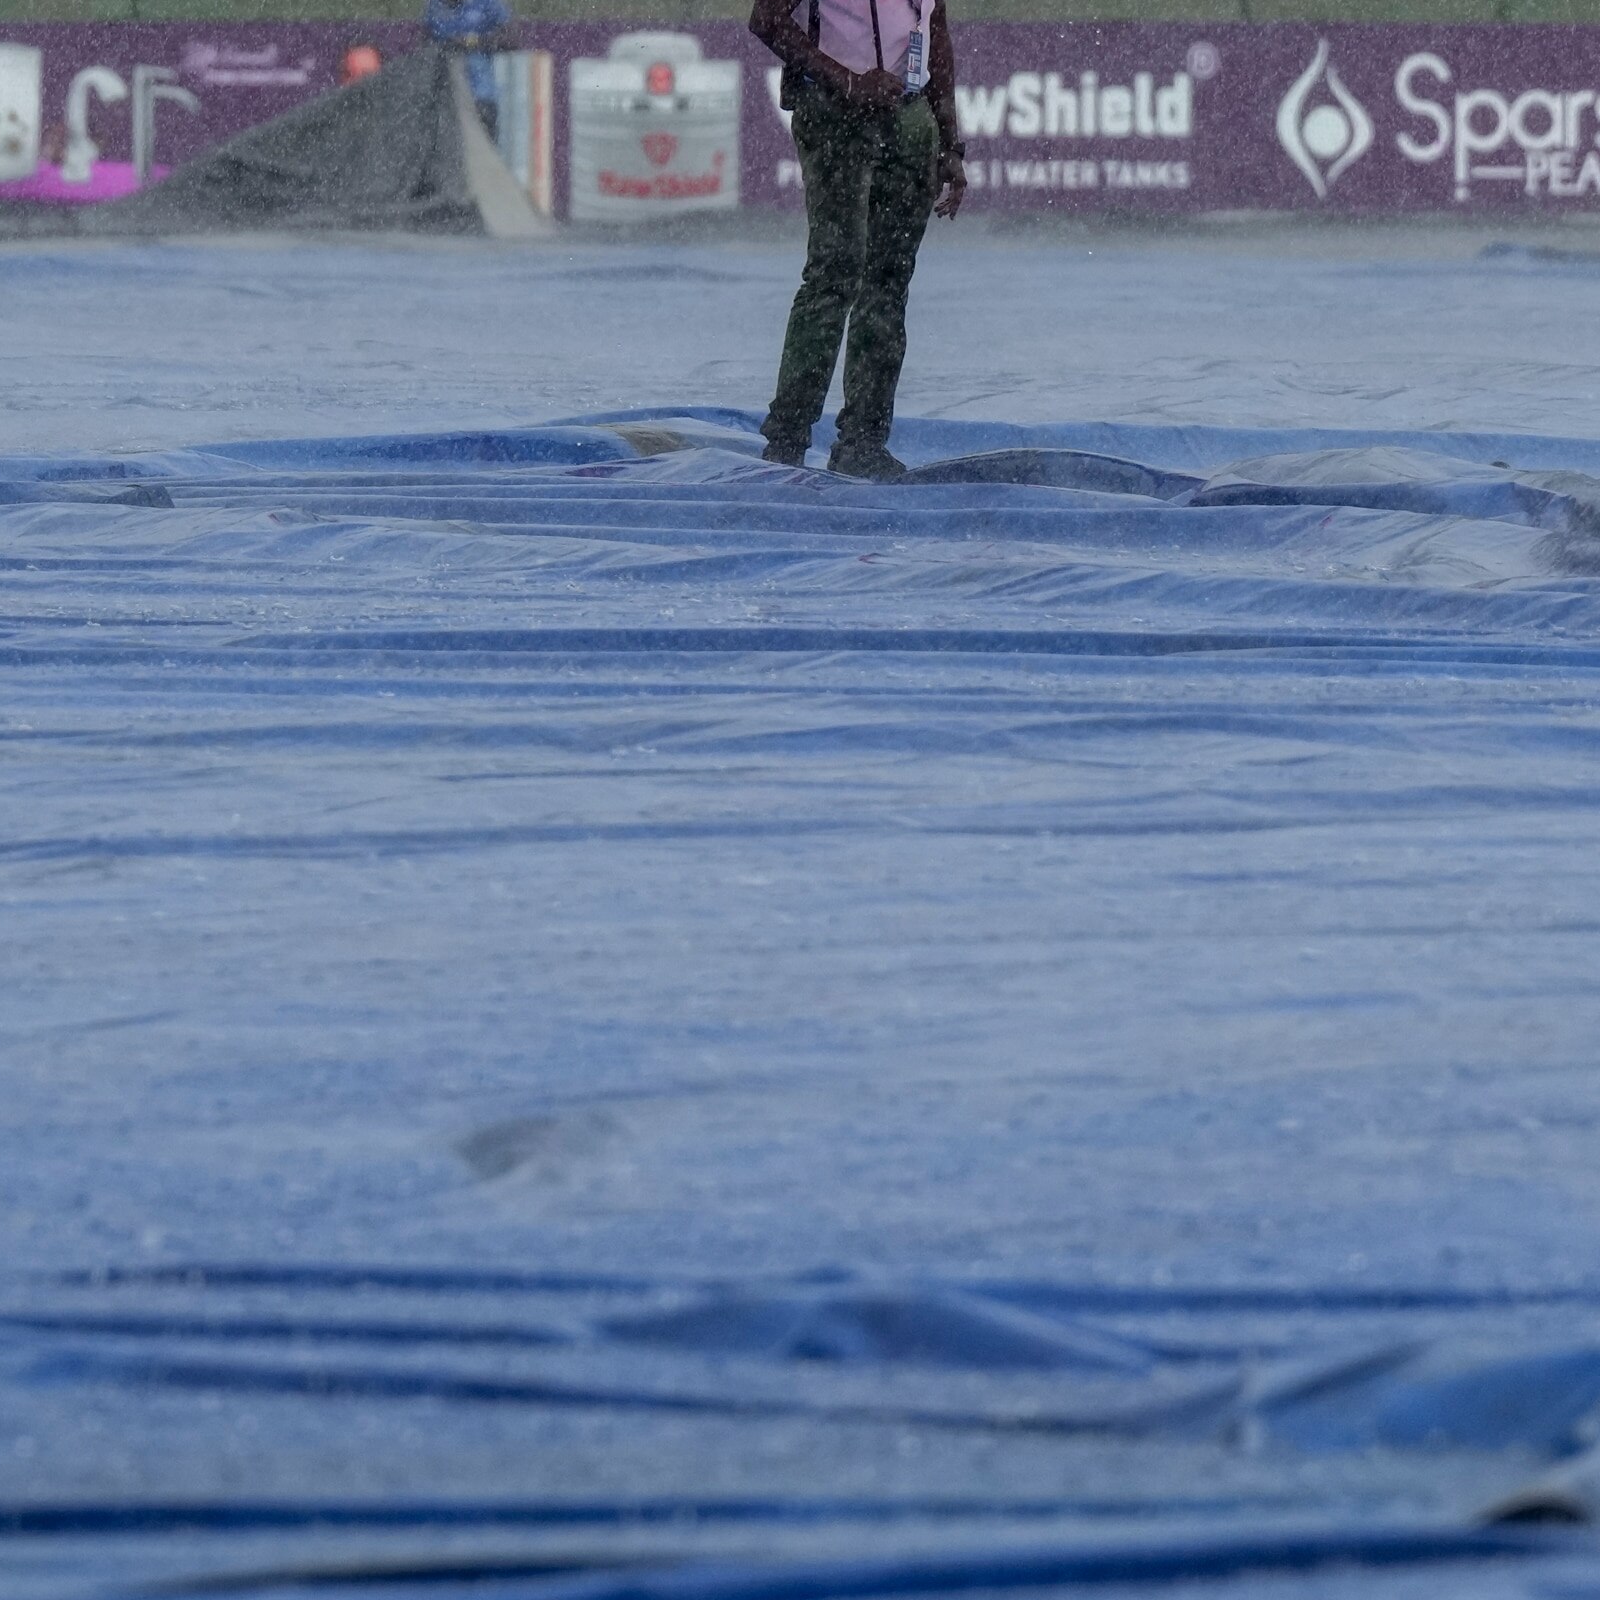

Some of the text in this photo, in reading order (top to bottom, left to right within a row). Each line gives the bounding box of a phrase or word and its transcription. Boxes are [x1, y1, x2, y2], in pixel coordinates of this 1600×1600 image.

[955, 72, 1191, 138] wShield
[1007, 161, 1097, 189] WATER
[1106, 161, 1190, 189] TANKS
